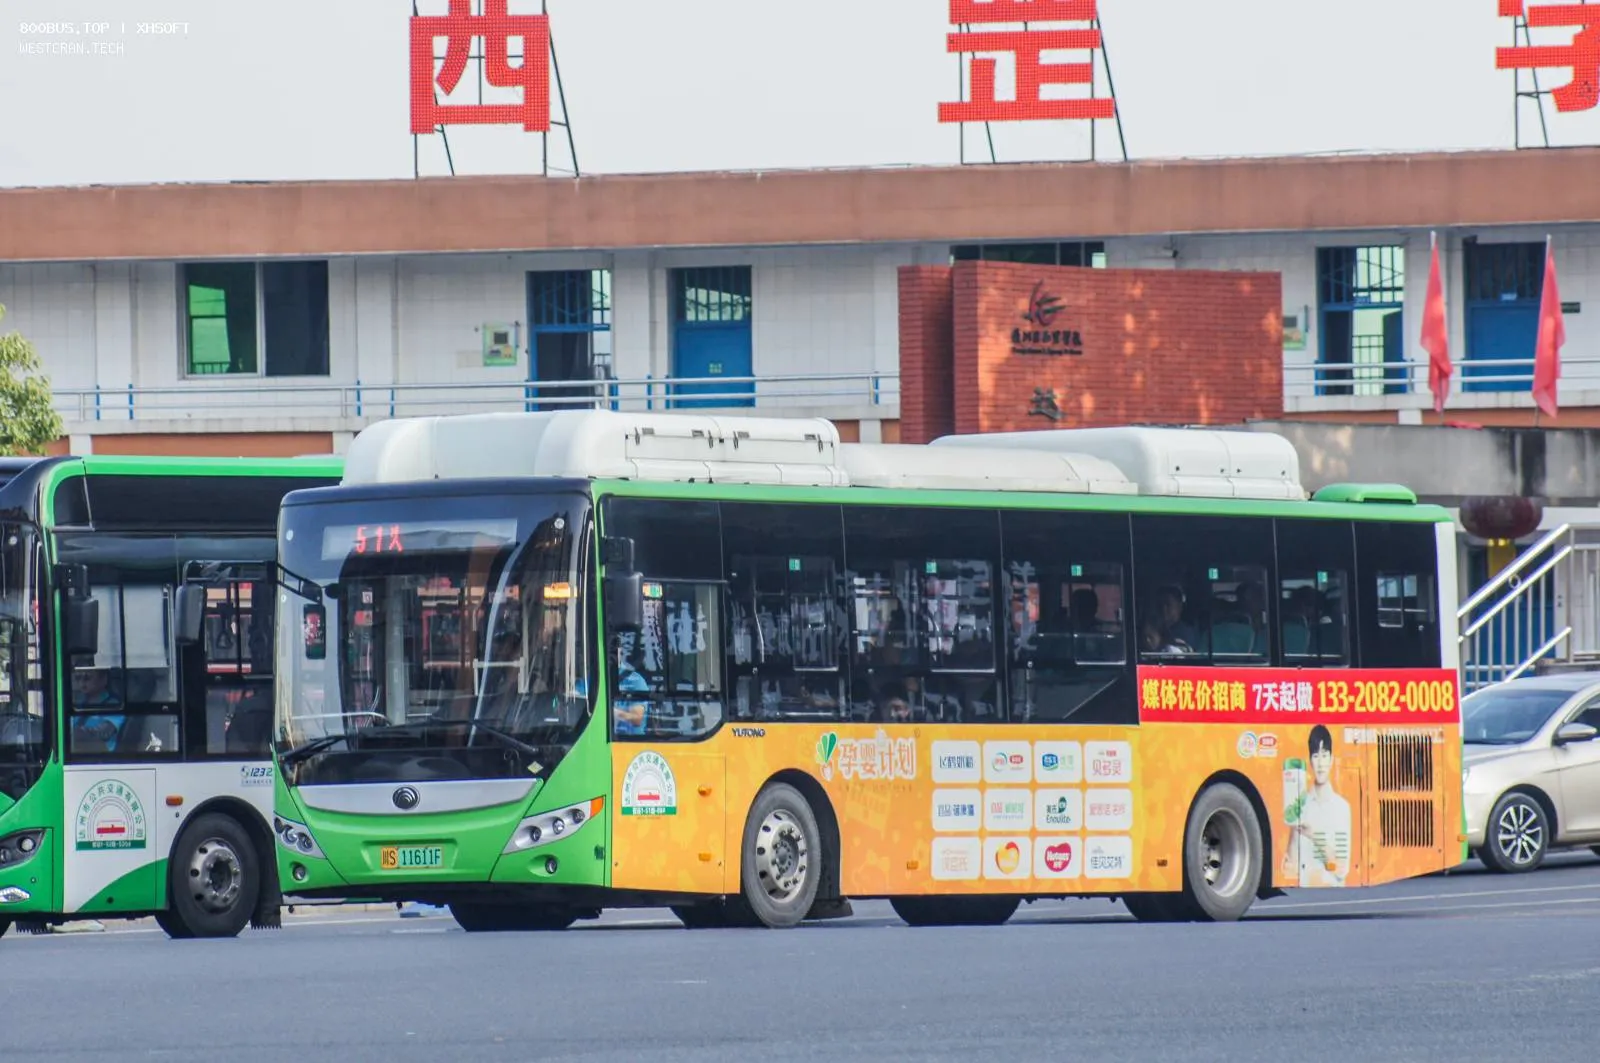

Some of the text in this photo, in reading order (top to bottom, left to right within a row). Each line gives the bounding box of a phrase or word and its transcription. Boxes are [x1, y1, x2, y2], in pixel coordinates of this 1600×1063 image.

[1142, 679, 1455, 713] 媒体优价招商 7天起做 133-2082-0008
[731, 727, 766, 738] YUTONG
